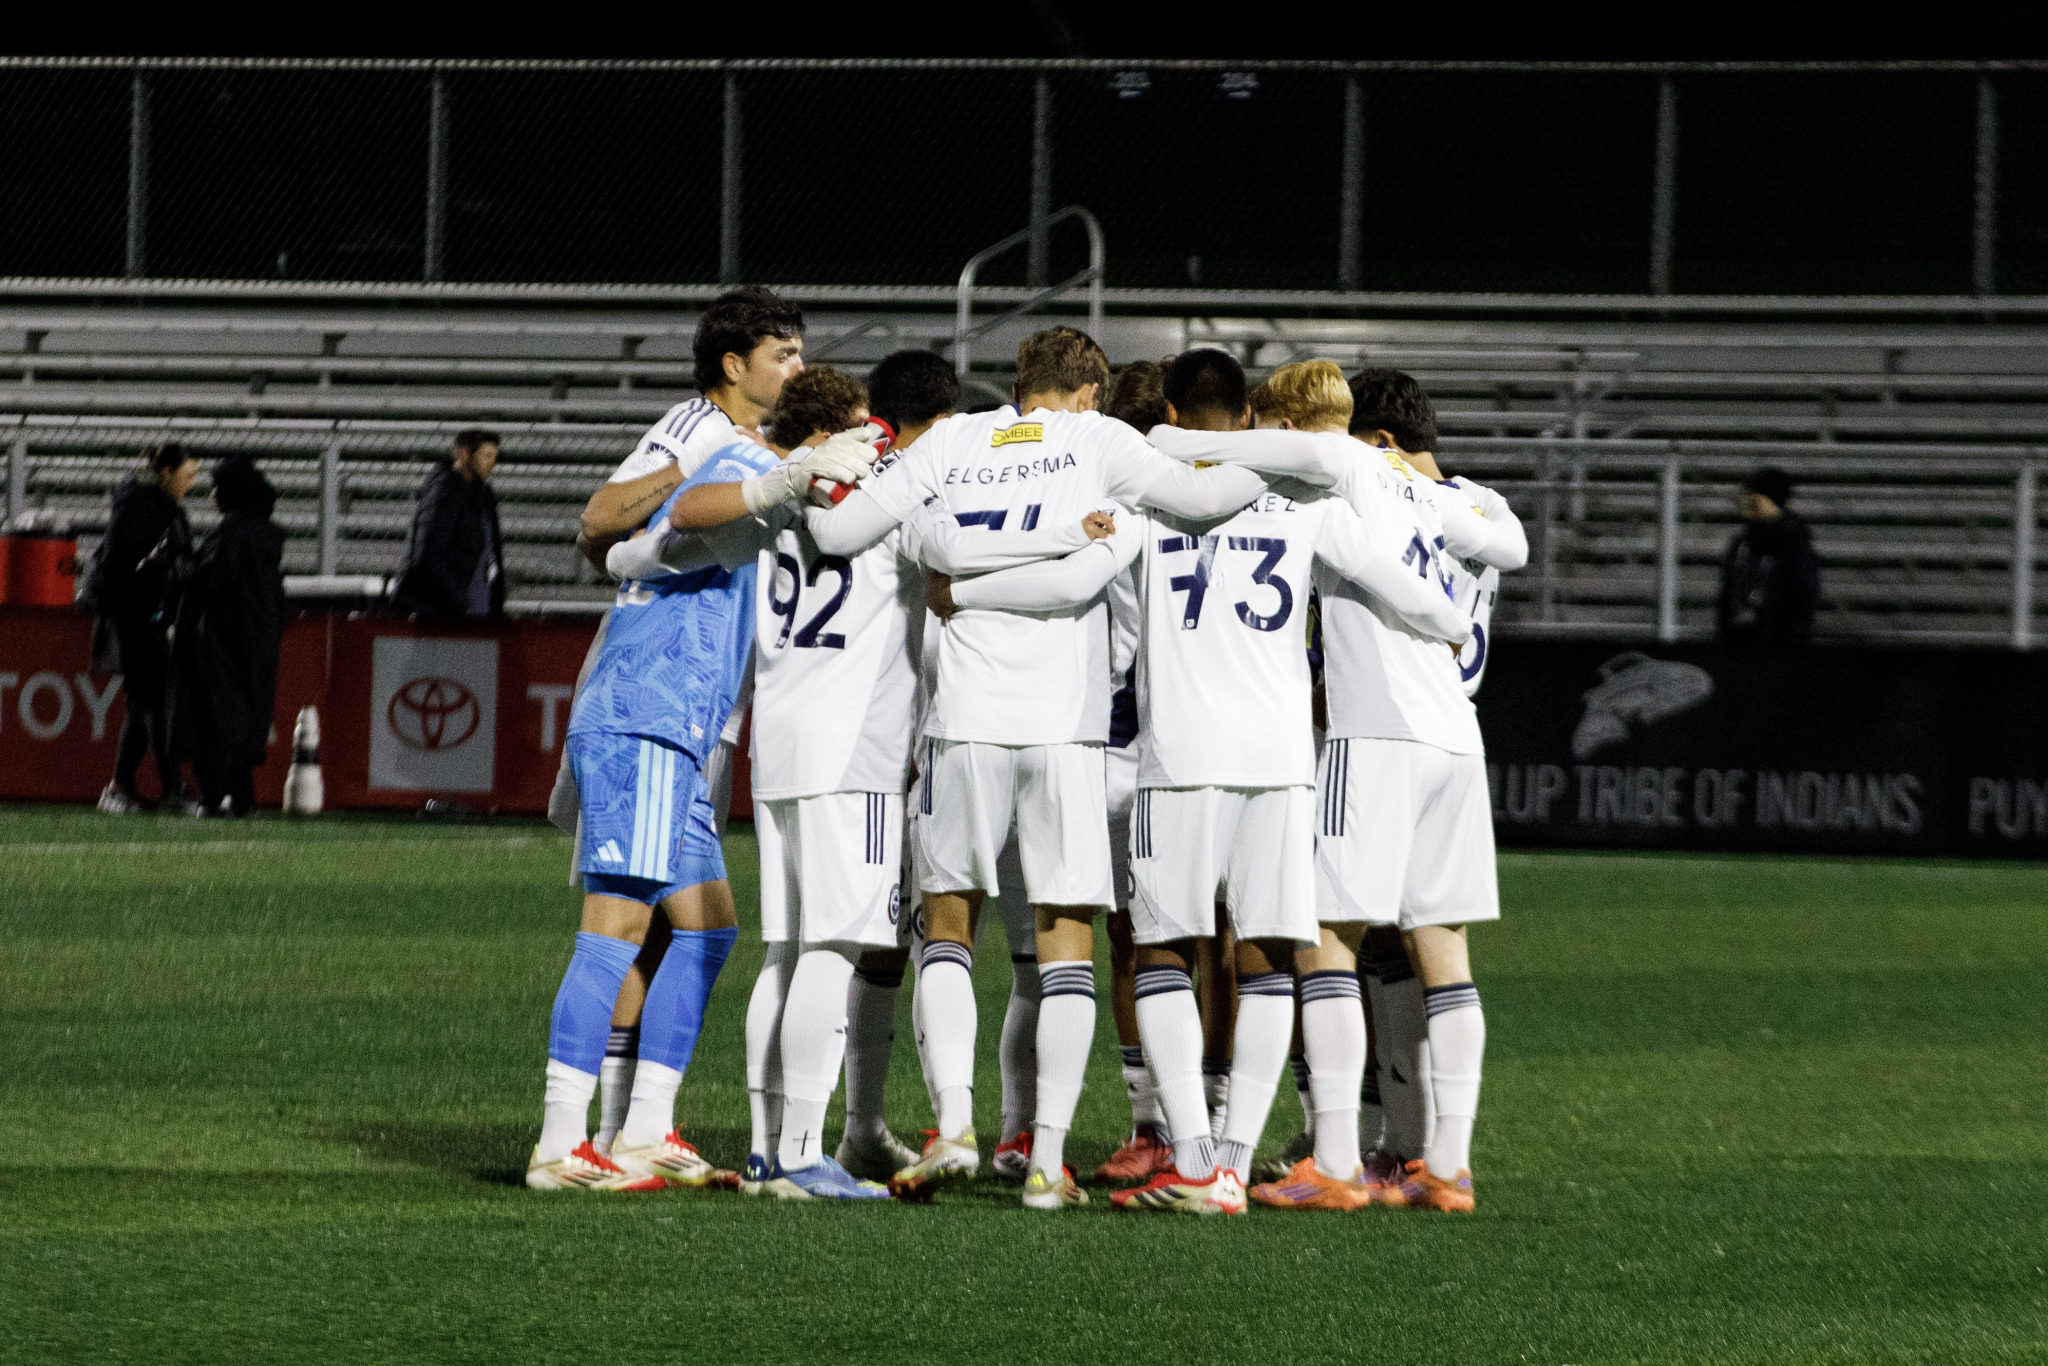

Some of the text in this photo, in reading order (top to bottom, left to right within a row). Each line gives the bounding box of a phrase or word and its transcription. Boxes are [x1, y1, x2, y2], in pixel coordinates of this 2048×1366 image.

[945, 453, 1077, 485] ELGERSMA
[768, 552, 853, 650] 92
[1157, 534, 1293, 632] 73
[1573, 763, 1689, 829] TRIBE
[1692, 766, 1749, 831] OF
[1755, 768, 1924, 834] INDIANS
